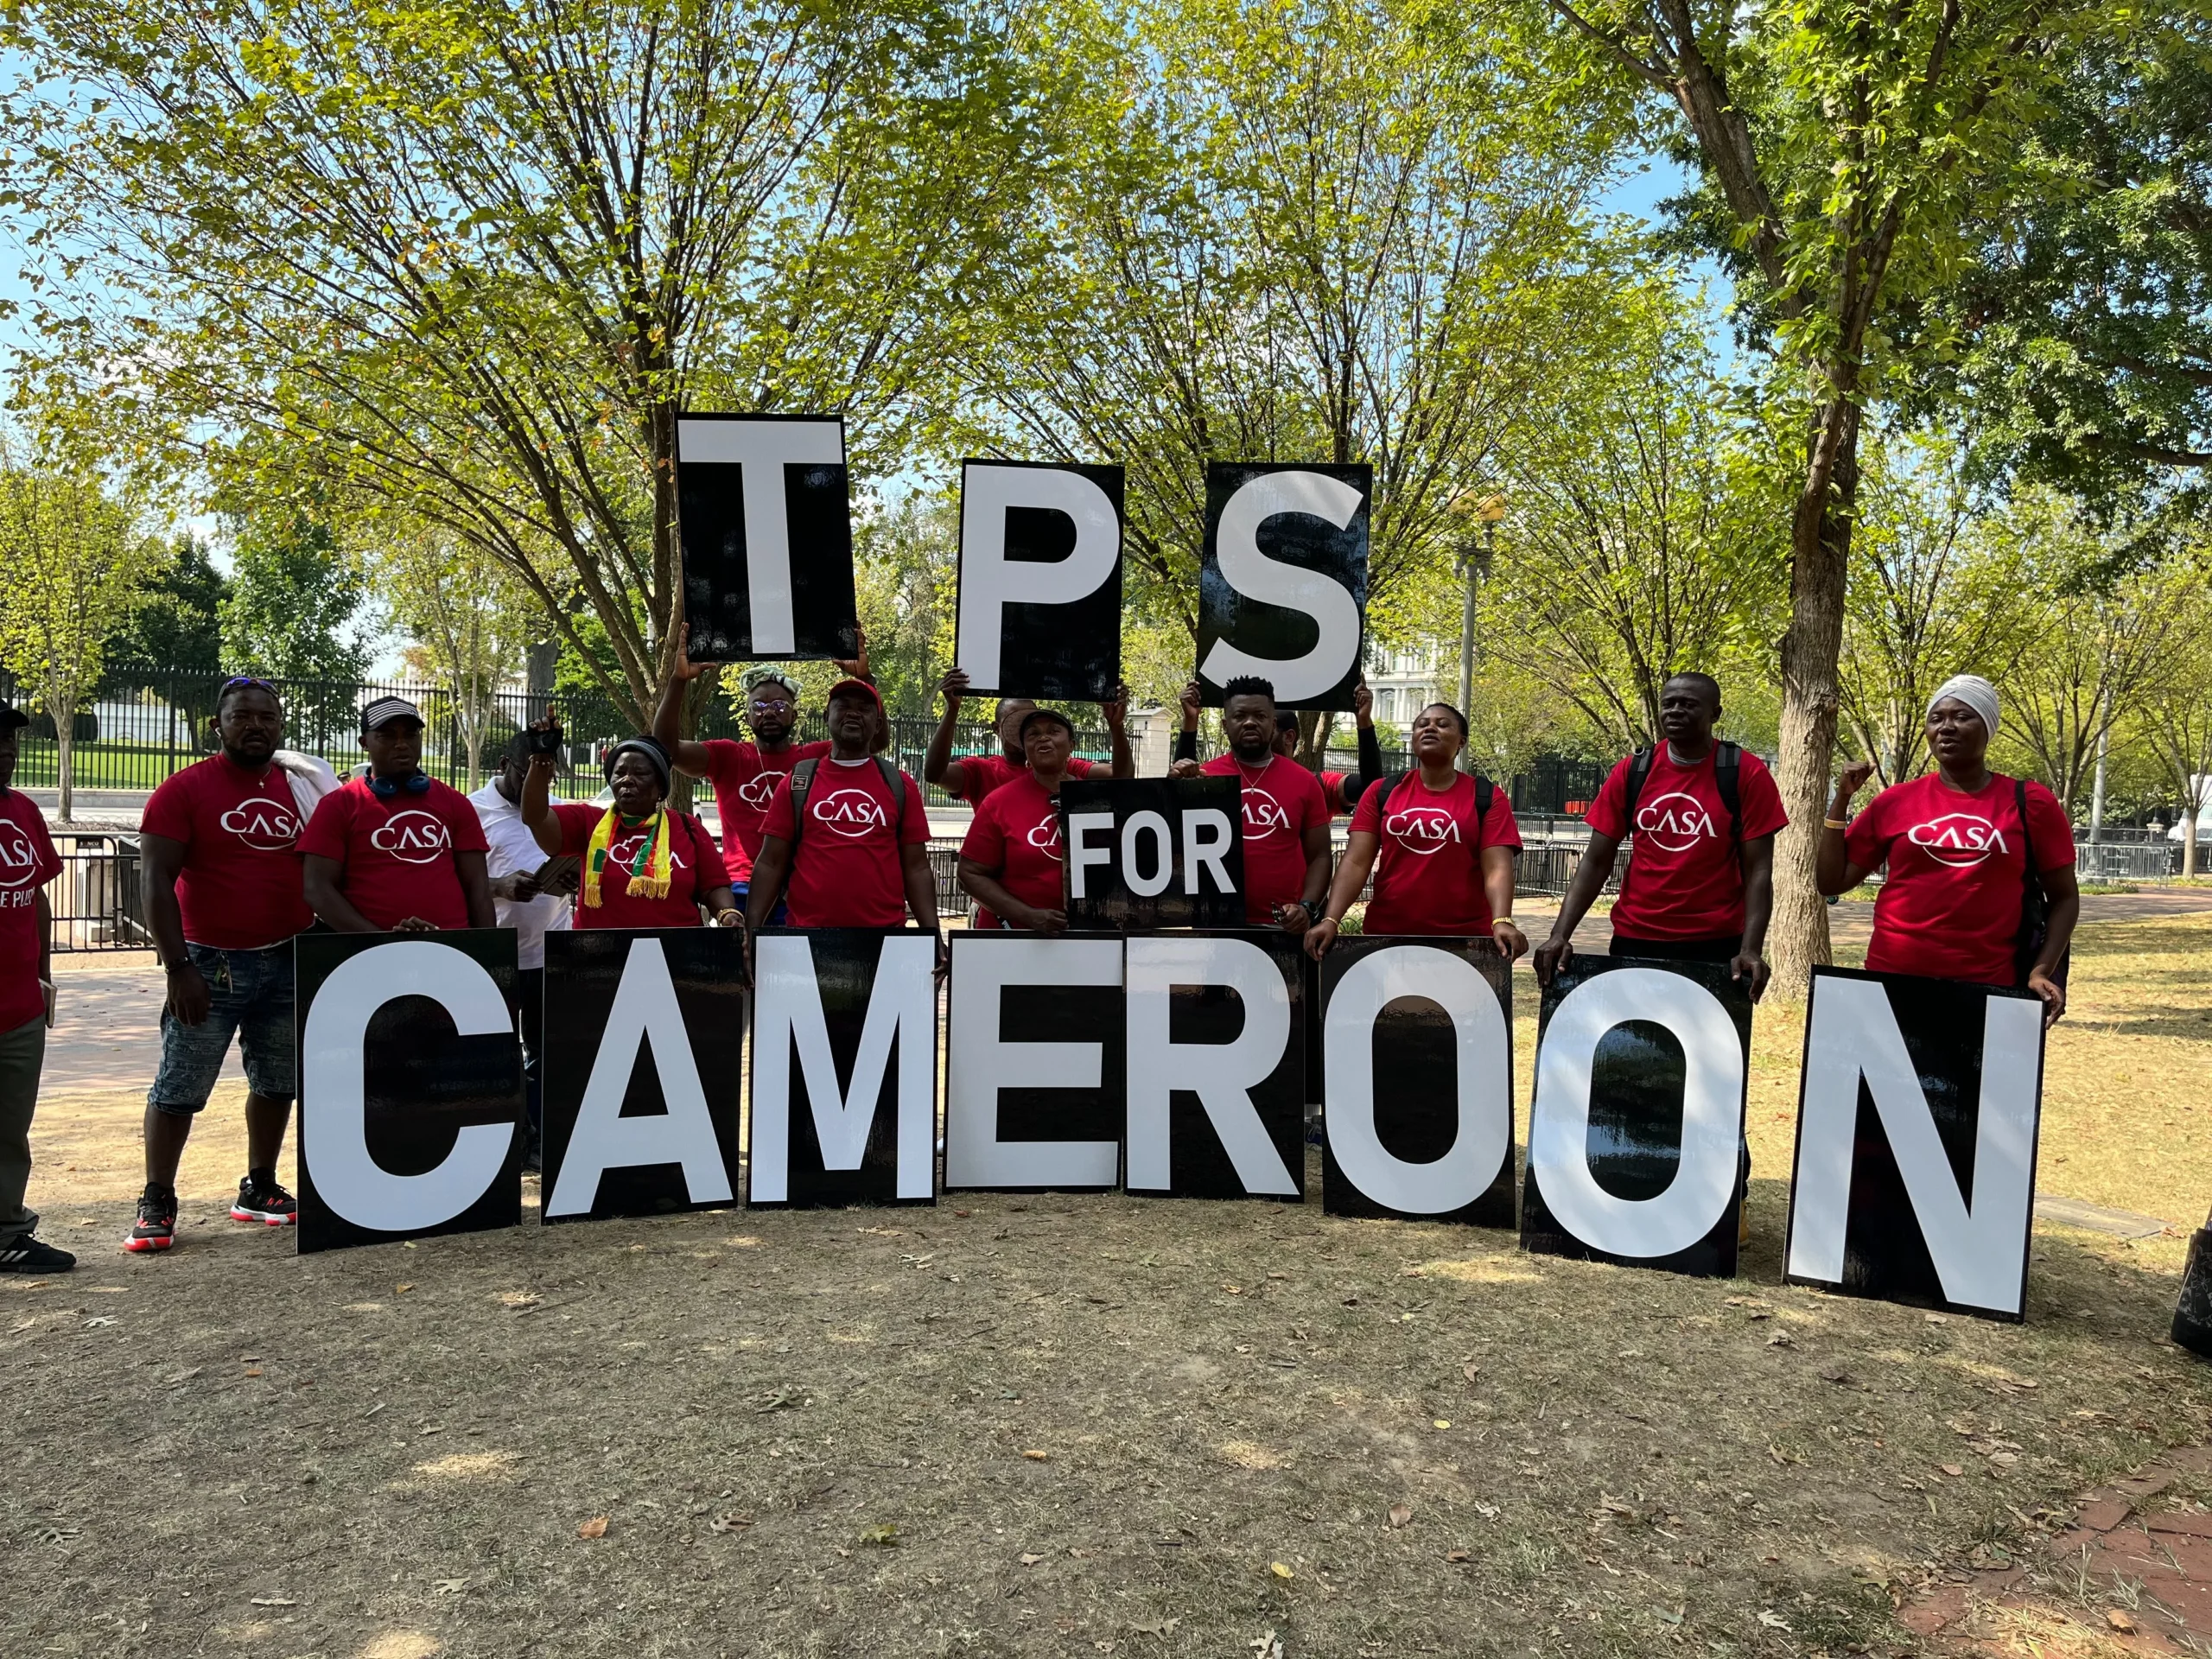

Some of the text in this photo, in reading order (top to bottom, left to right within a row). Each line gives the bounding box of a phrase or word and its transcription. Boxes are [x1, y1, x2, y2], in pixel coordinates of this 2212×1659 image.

[678, 420, 1363, 702] TPS
[739, 784, 774, 804] CA
[219, 810, 305, 839] CASA
[813, 800, 887, 826] CASA
[1242, 802, 1292, 829] ASA
[1637, 807, 1718, 837] CASA
[371, 824, 453, 851] CASA
[1027, 826, 1063, 847] CA
[1386, 815, 1462, 843] CASA
[1907, 823, 2010, 854] CASA
[0, 840, 43, 867] ASA
[608, 843, 688, 868] CA
[1068, 809, 1237, 899] FOR
[303, 936, 2043, 1313] CAMEROON
